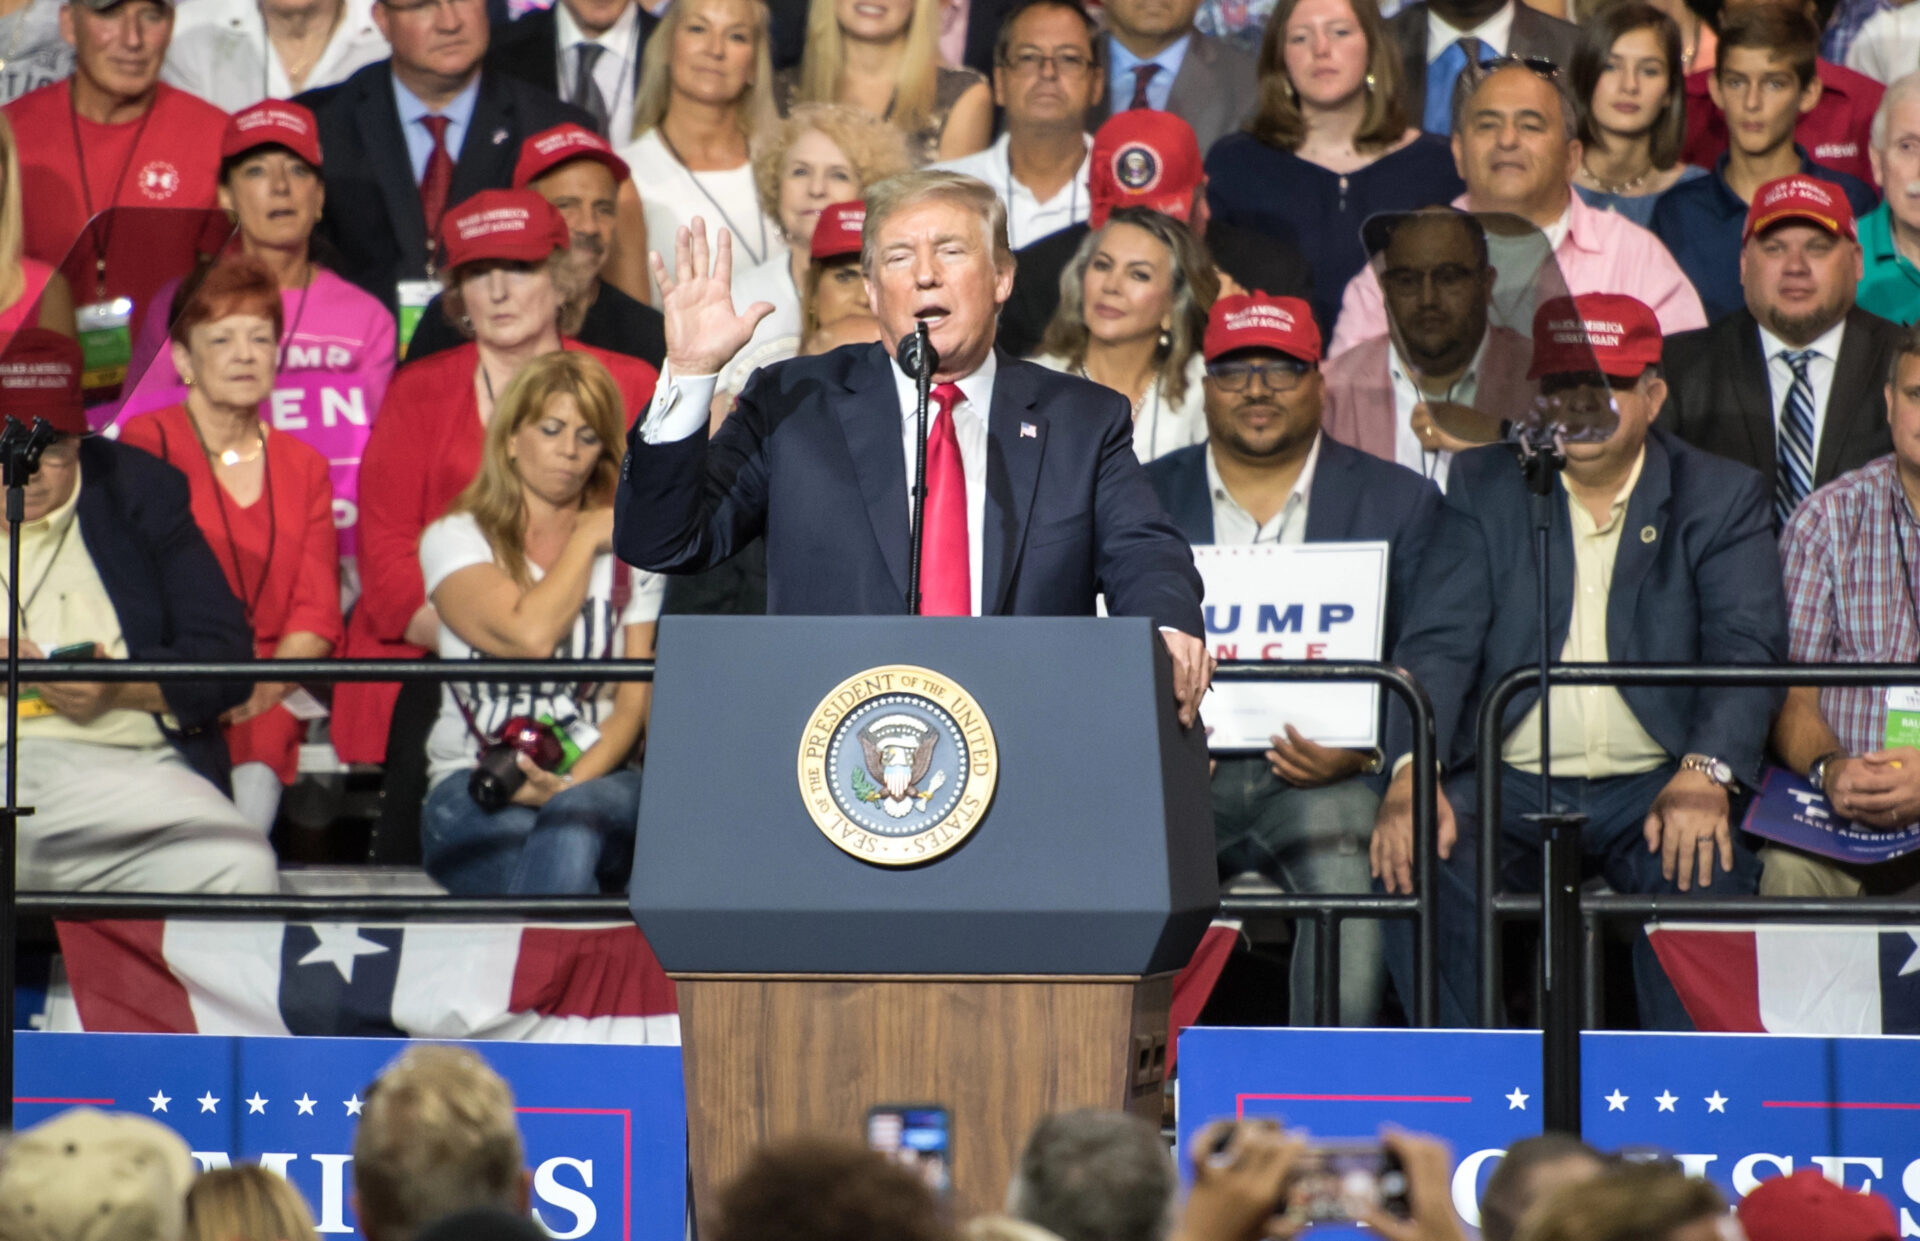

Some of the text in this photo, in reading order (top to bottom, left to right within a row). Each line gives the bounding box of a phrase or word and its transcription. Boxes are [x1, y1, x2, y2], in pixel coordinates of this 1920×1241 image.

[806, 673, 990, 854] SEAL OF THE PRESIDENT OF THE UNITED STATES
[1838, 828, 1905, 842] AMERICA
